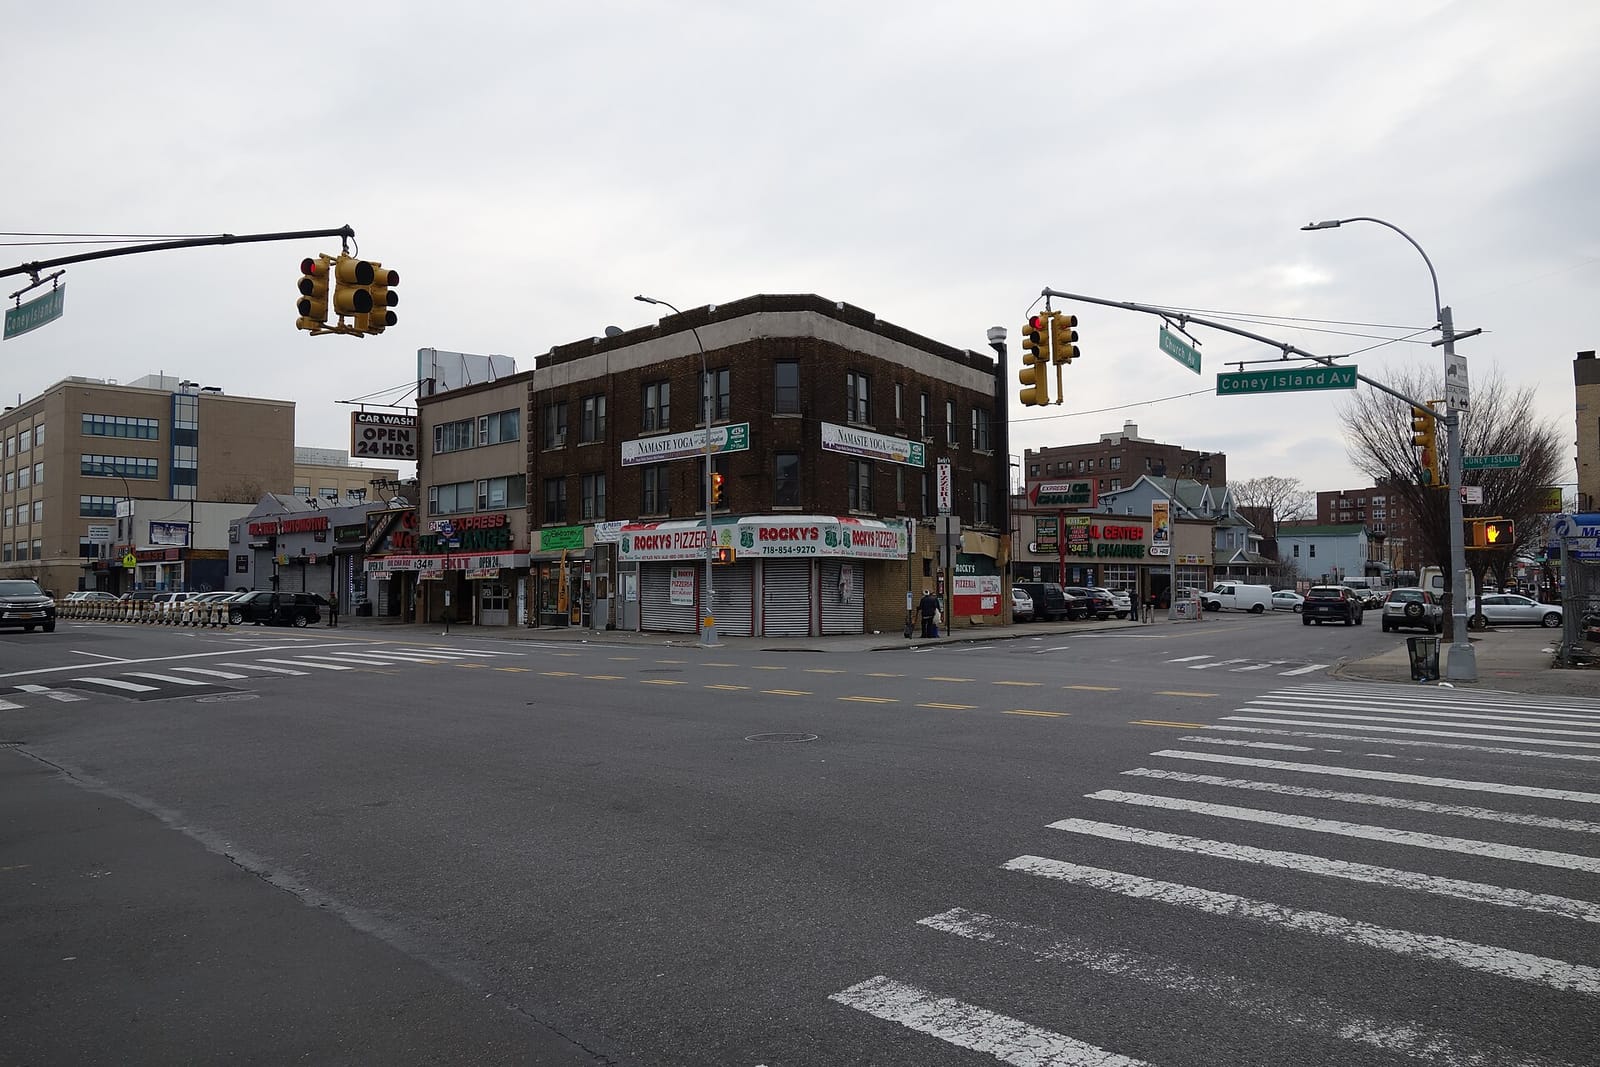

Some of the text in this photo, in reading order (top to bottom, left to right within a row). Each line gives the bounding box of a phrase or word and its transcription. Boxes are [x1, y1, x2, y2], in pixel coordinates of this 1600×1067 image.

[7, 311, 31, 331] Coney
[1165, 337, 1196, 365] Church Av
[1222, 371, 1351, 390] Coney Island Av
[359, 414, 414, 426] CAR WASH
[363, 427, 410, 442] OPEN
[837, 429, 868, 447] NAMASTE
[869, 437, 886, 450] YOGA
[357, 440, 415, 456] 24 HRS
[638, 440, 671, 455] NAMASTE
[674, 436, 694, 449] YOGA
[1464, 455, 1519, 465] CONEY ISLAND
[940, 465, 948, 507] PIZZERIA
[450, 514, 506, 529] EXPRESS
[674, 529, 718, 549] PIZZERA
[759, 526, 819, 541] ROCKY'S
[875, 530, 898, 548] PIZZERIA
[1103, 525, 1144, 540] CENTER
[762, 545, 816, 554] 718-854-9270
[1097, 543, 1145, 558] CHANGE
[441, 557, 471, 570] EXIT
